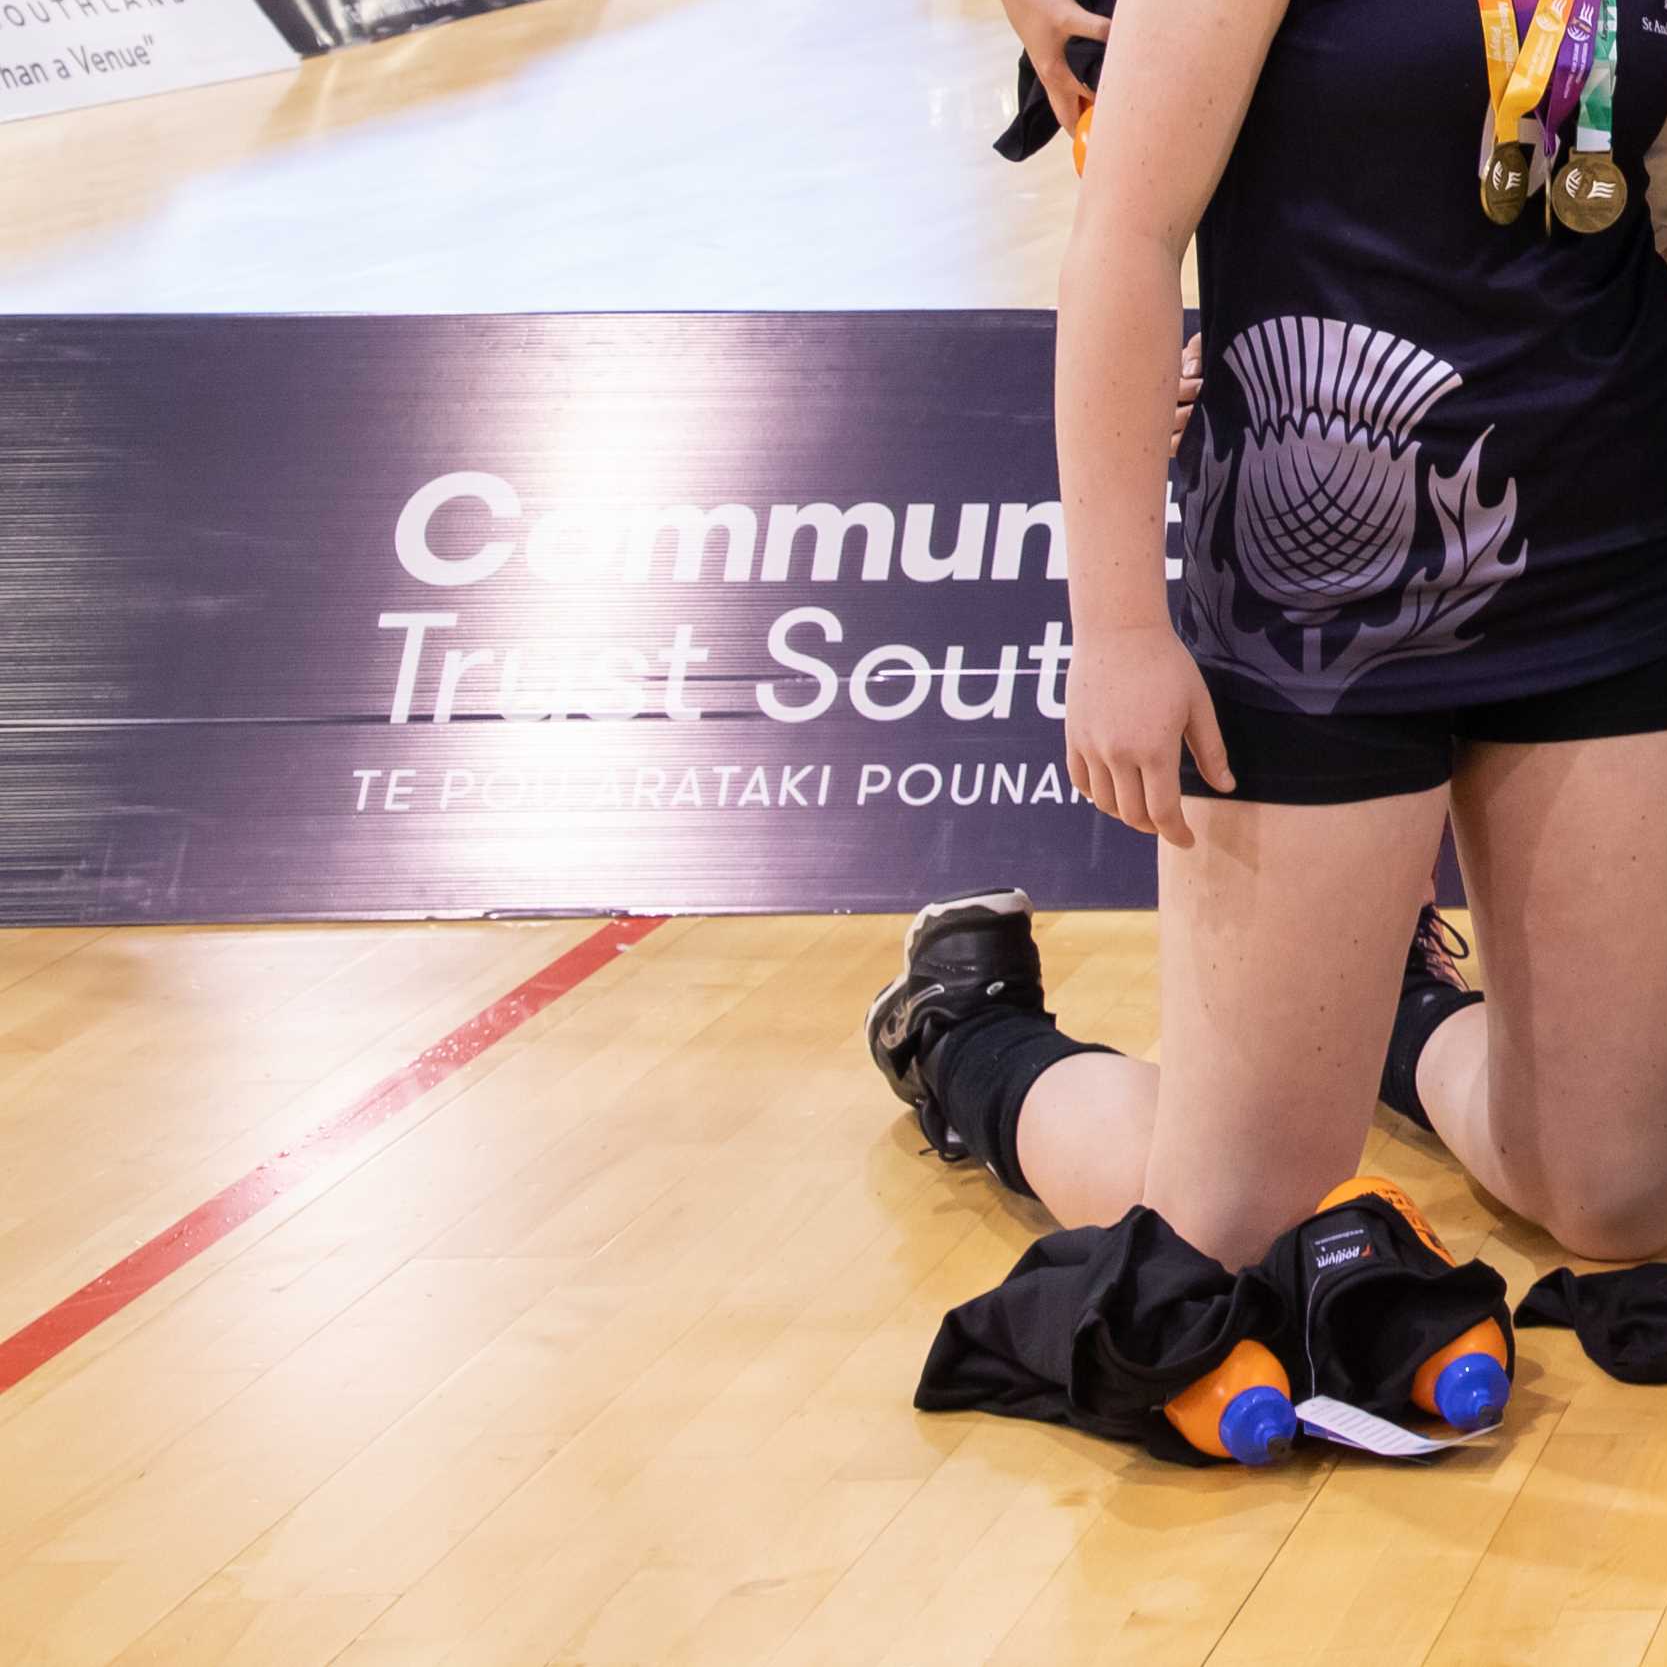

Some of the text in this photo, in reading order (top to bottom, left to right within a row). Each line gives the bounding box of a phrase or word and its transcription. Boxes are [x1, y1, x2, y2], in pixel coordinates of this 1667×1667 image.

[53, 58, 71, 80] a
[377, 606, 1073, 724] Trust Sout
[352, 768, 416, 812] TE
